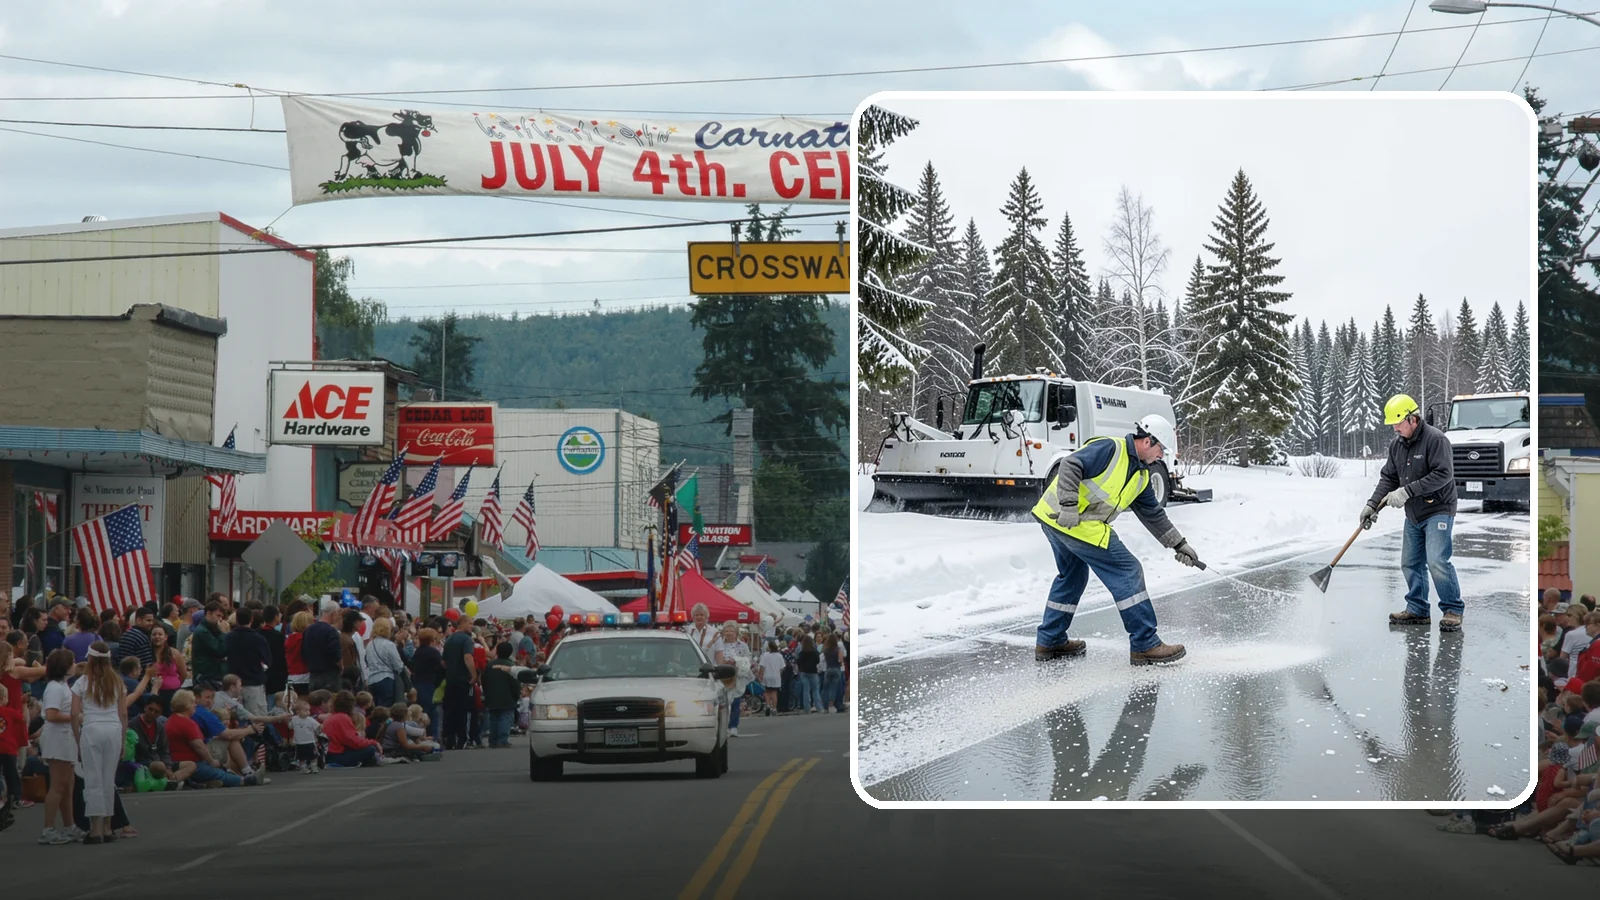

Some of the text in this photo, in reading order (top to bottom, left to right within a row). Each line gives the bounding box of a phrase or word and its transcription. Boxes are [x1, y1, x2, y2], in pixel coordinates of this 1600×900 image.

[481, 141, 604, 192] JULY
[632, 150, 746, 198] 4th.
[697, 254, 850, 279] CROSSWA
[283, 380, 373, 420] ACE
[405, 409, 486, 422] CEDAR LOG
[283, 421, 371, 436] Hardware
[353, 467, 386, 480] Simpl
[95, 485, 124, 495] Vincent
[126, 486, 136, 495] de
[137, 486, 155, 495] Paul
[212, 516, 331, 535] HARDARE
[688, 527, 741, 535] CRNATION
[699, 535, 730, 543] GLASS
